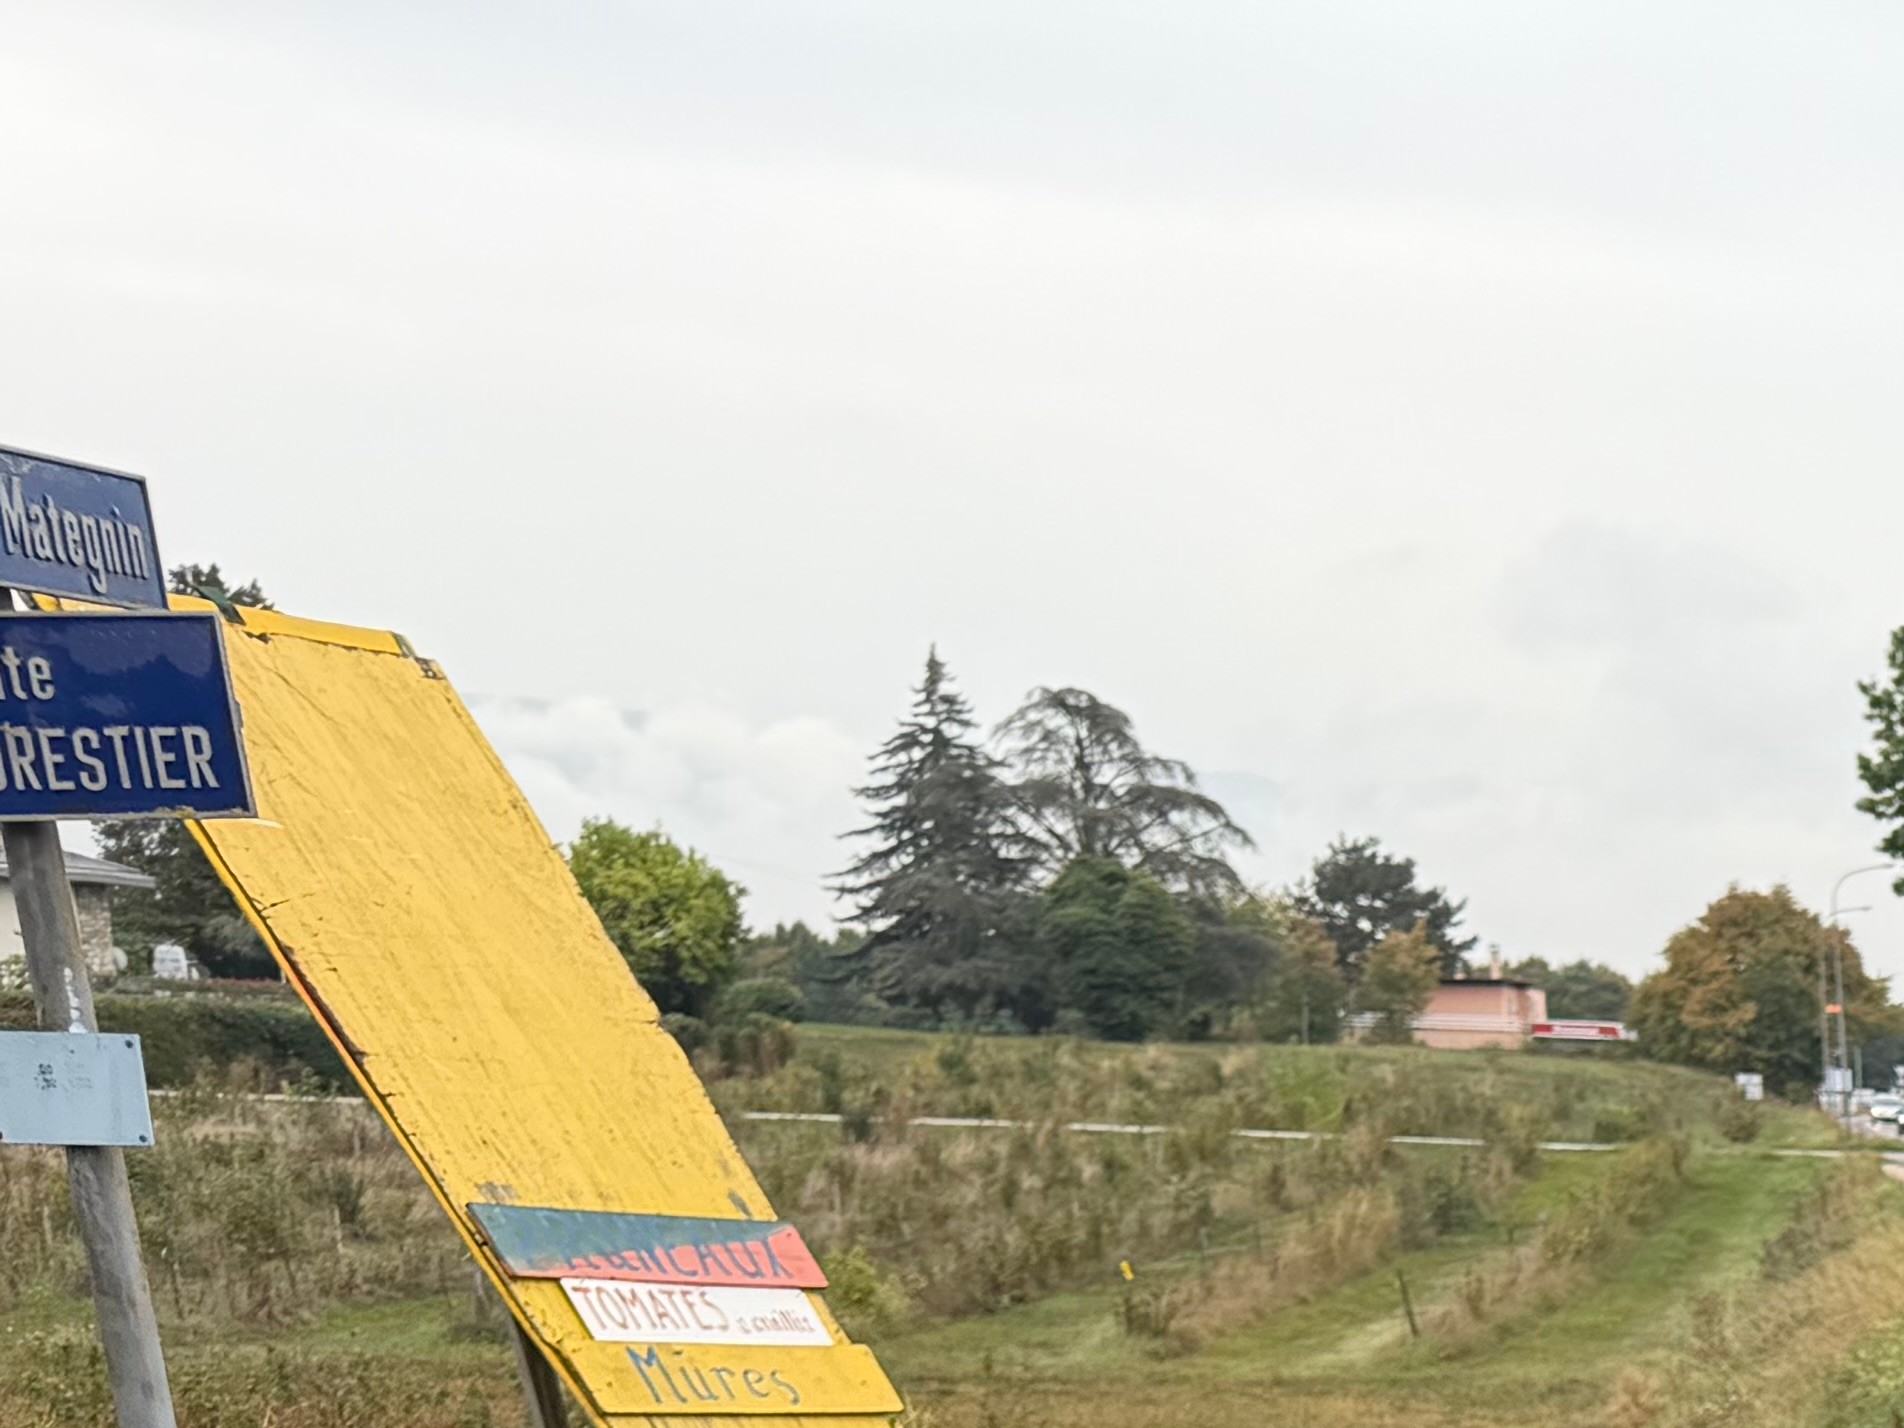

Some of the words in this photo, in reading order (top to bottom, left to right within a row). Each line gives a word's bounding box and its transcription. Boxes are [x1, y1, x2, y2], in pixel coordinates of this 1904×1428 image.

[0, 474, 149, 593] Mategnin
[0, 646, 56, 700] te
[0, 722, 220, 791] RESTIER
[571, 1286, 730, 1331] TOMATES
